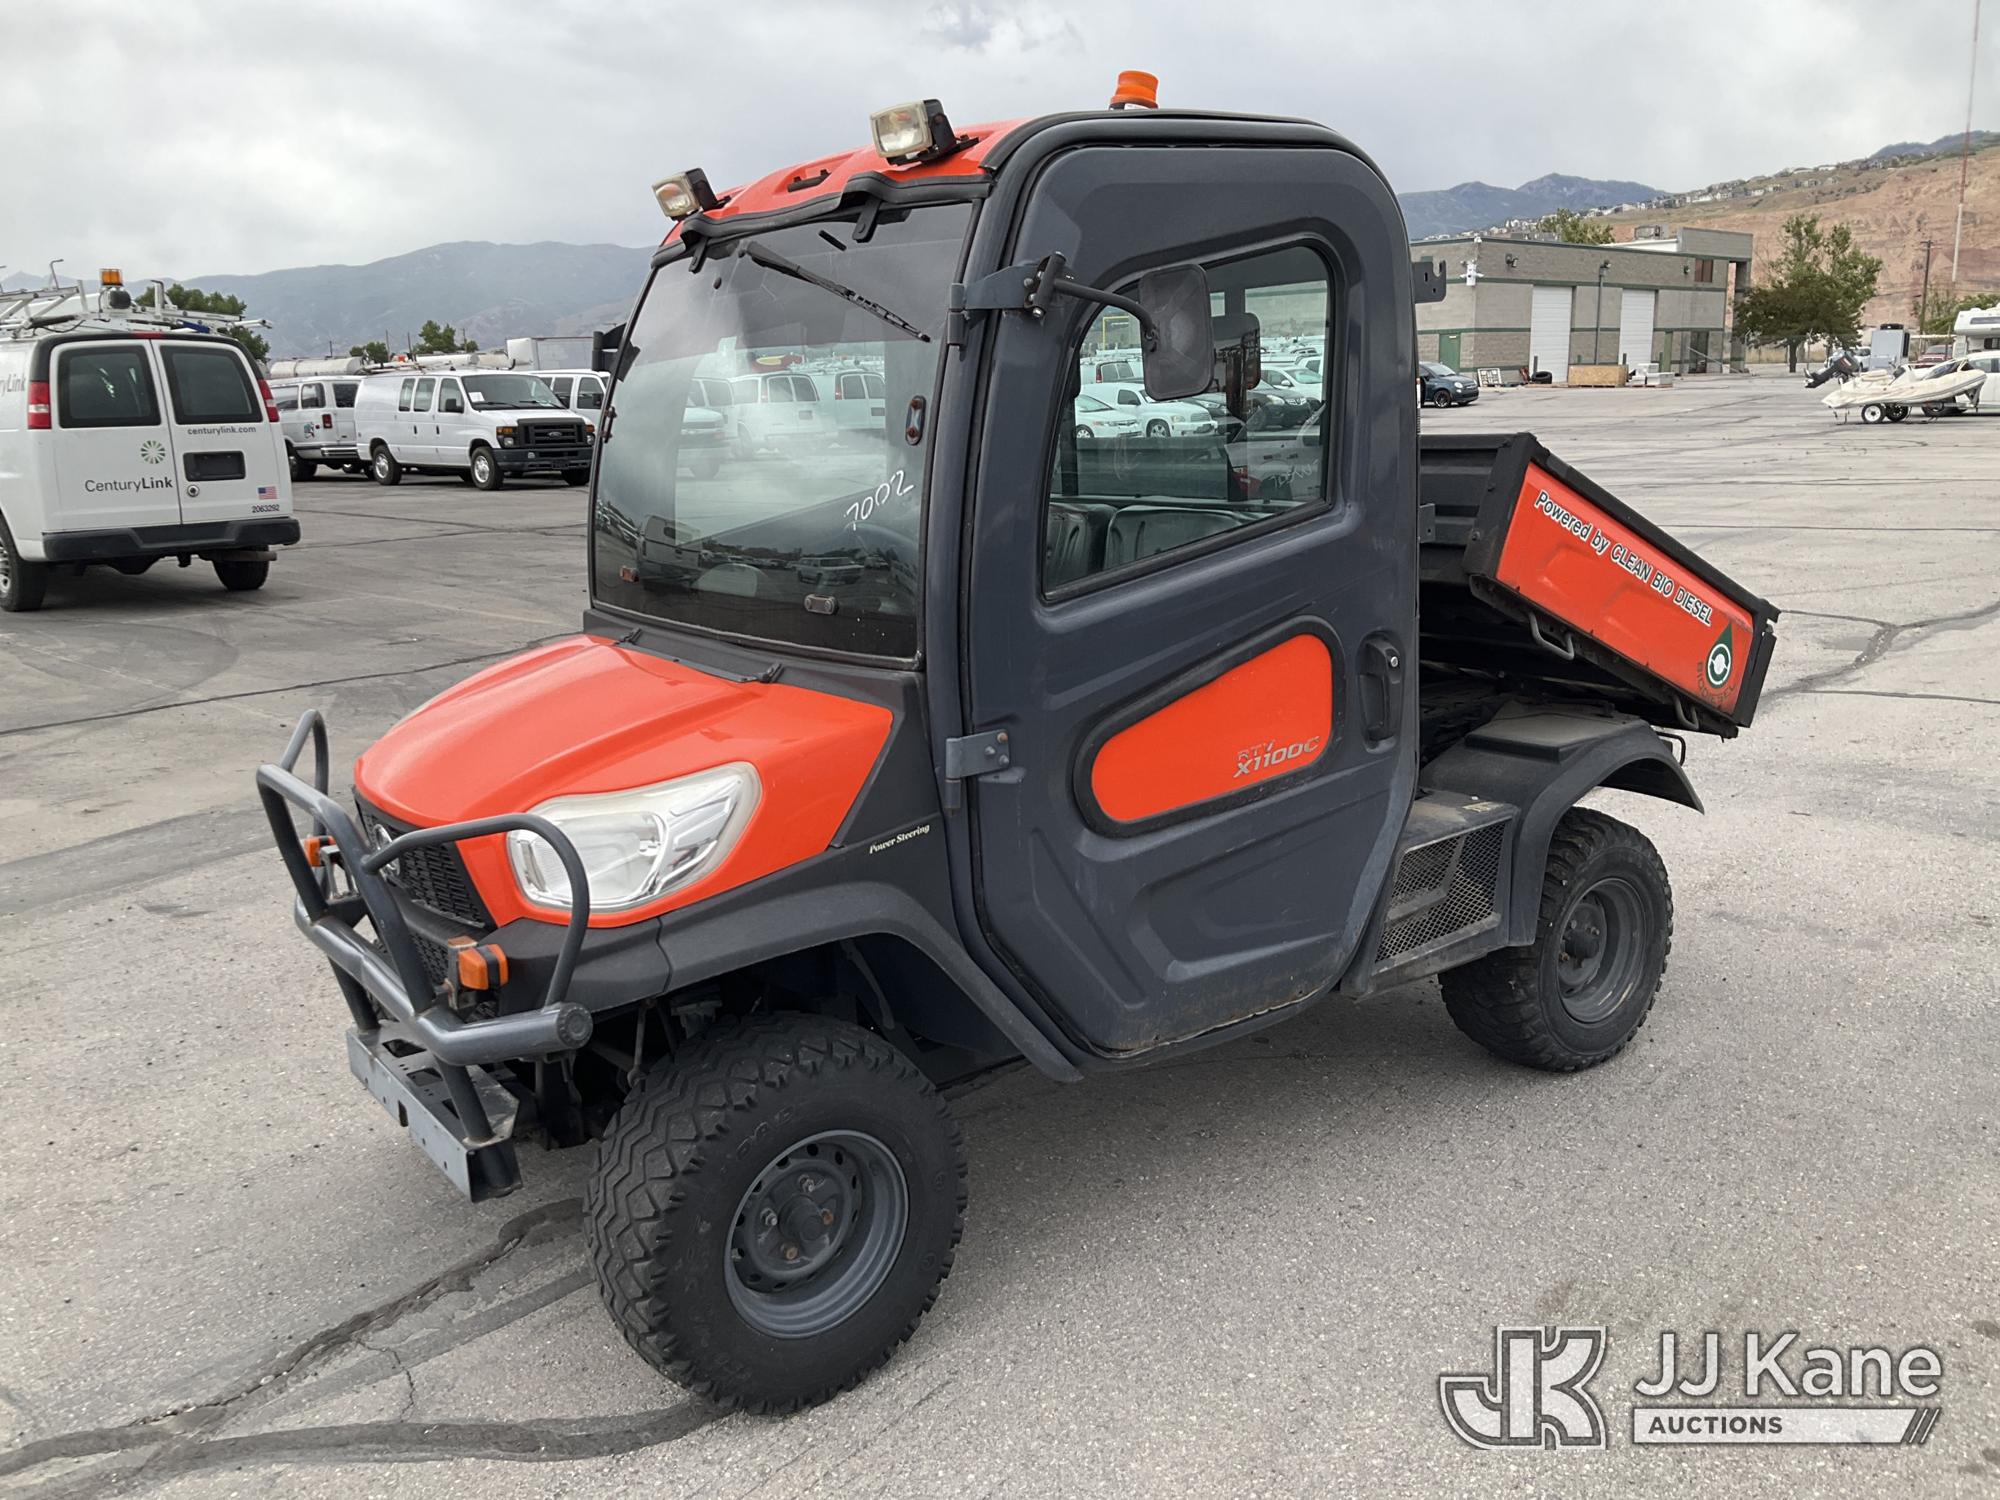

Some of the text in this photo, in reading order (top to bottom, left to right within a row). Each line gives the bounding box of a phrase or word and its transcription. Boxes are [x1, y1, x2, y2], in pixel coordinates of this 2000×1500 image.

[187, 425, 257, 435] centurylink.com
[85, 477, 173, 493] CenturyLink
[843, 469, 914, 531] 7002
[252, 504, 280, 514] 2063292
[1535, 490, 1712, 625] Powered by CLEAN BIO DIESEL
[1233, 735, 1320, 778] X1100C
[869, 824, 930, 854] Power Steering
